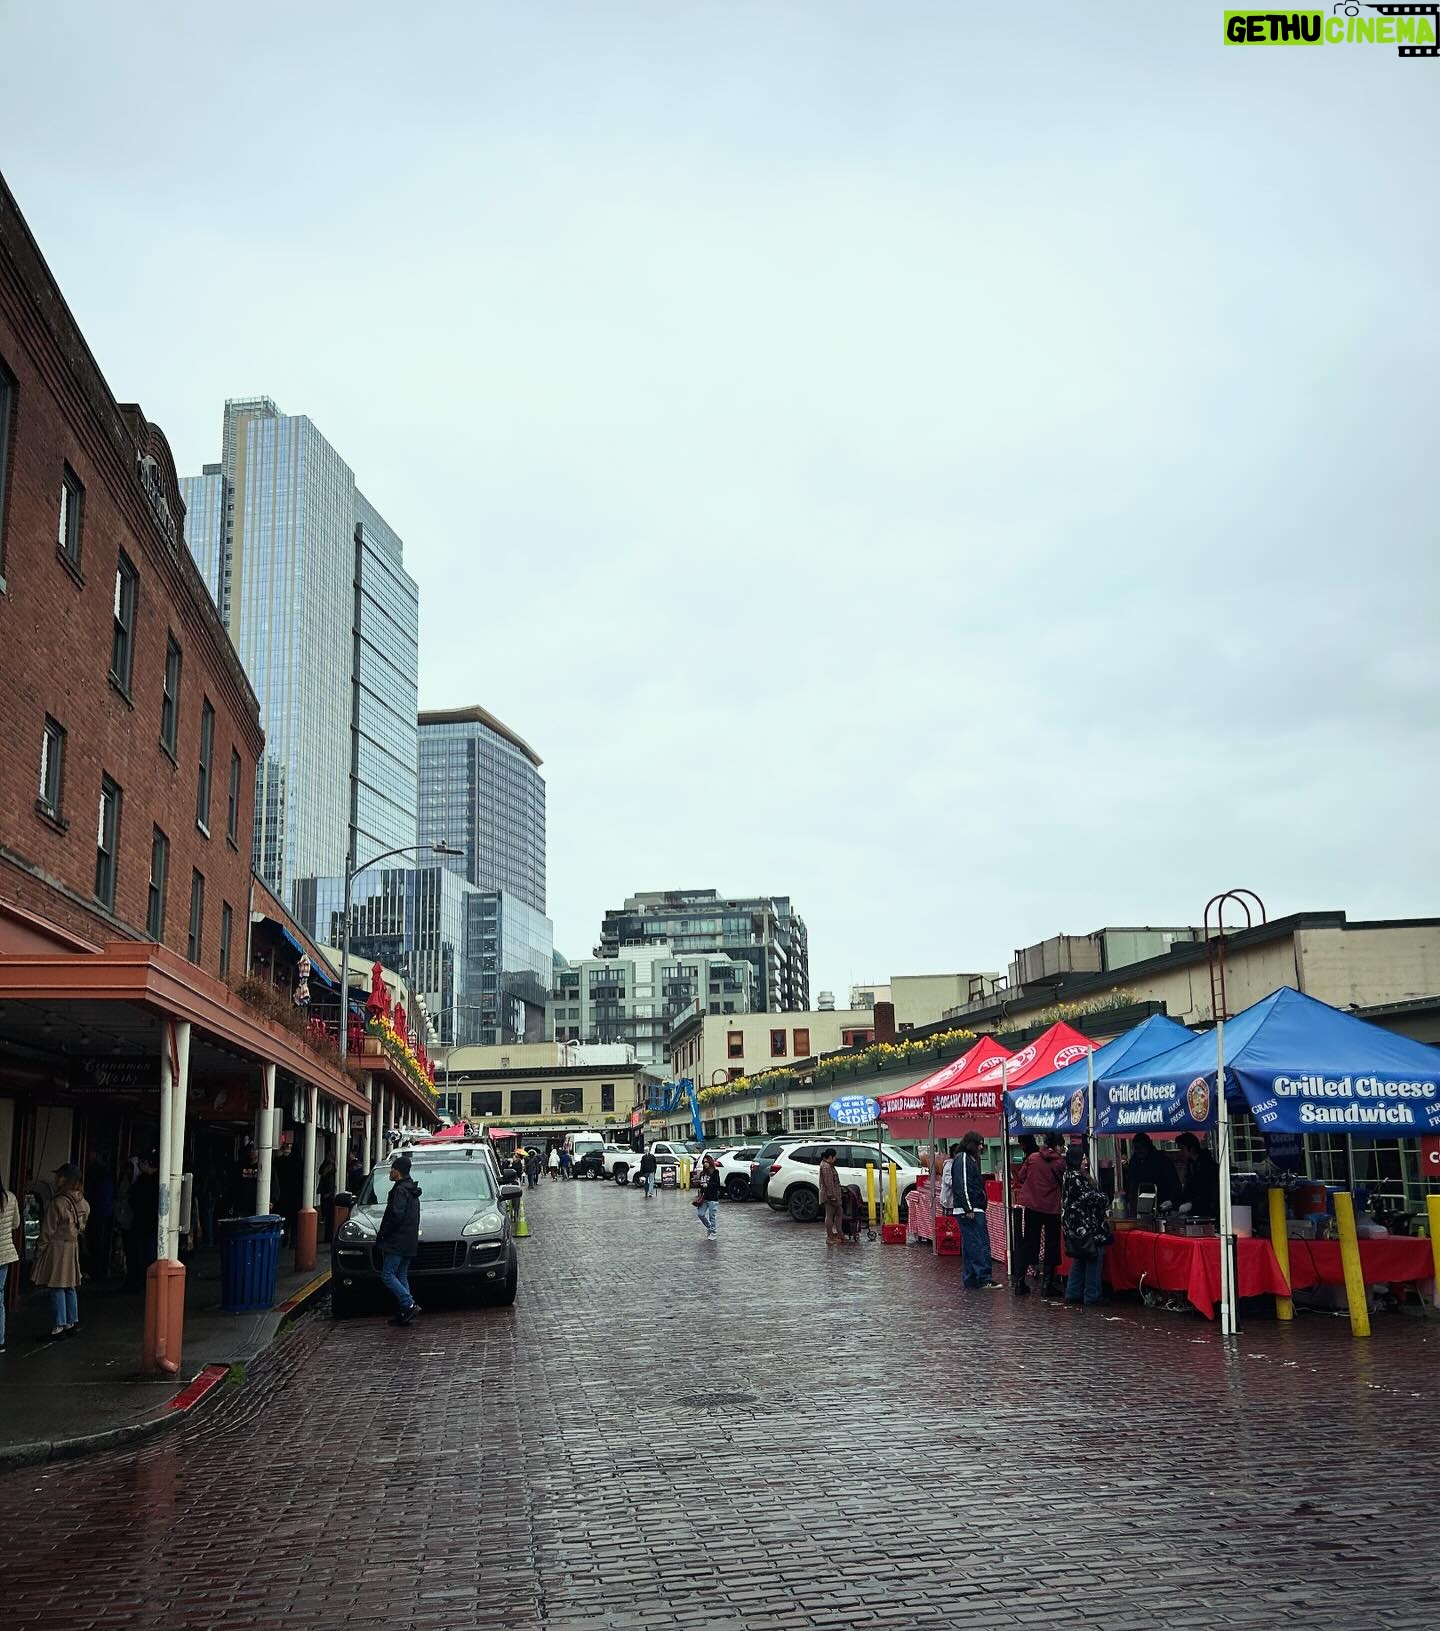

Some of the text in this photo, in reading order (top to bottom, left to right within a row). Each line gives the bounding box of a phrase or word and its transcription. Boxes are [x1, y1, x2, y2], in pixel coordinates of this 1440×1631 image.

[1108, 1082, 1141, 1103] Grilled
[1140, 1081, 1176, 1101] Cheese
[1272, 1074, 1437, 1099] Grilled Cheese
[1014, 1092, 1042, 1110] Grilled
[1251, 1098, 1278, 1115] GRASS
[837, 1106, 875, 1117] APPLE
[837, 1113, 876, 1124] CIDER
[1020, 1111, 1056, 1129] Sandwich
[1117, 1103, 1164, 1126] Sandwich
[1262, 1111, 1278, 1124] FED
[1299, 1101, 1415, 1125] Sandwich
